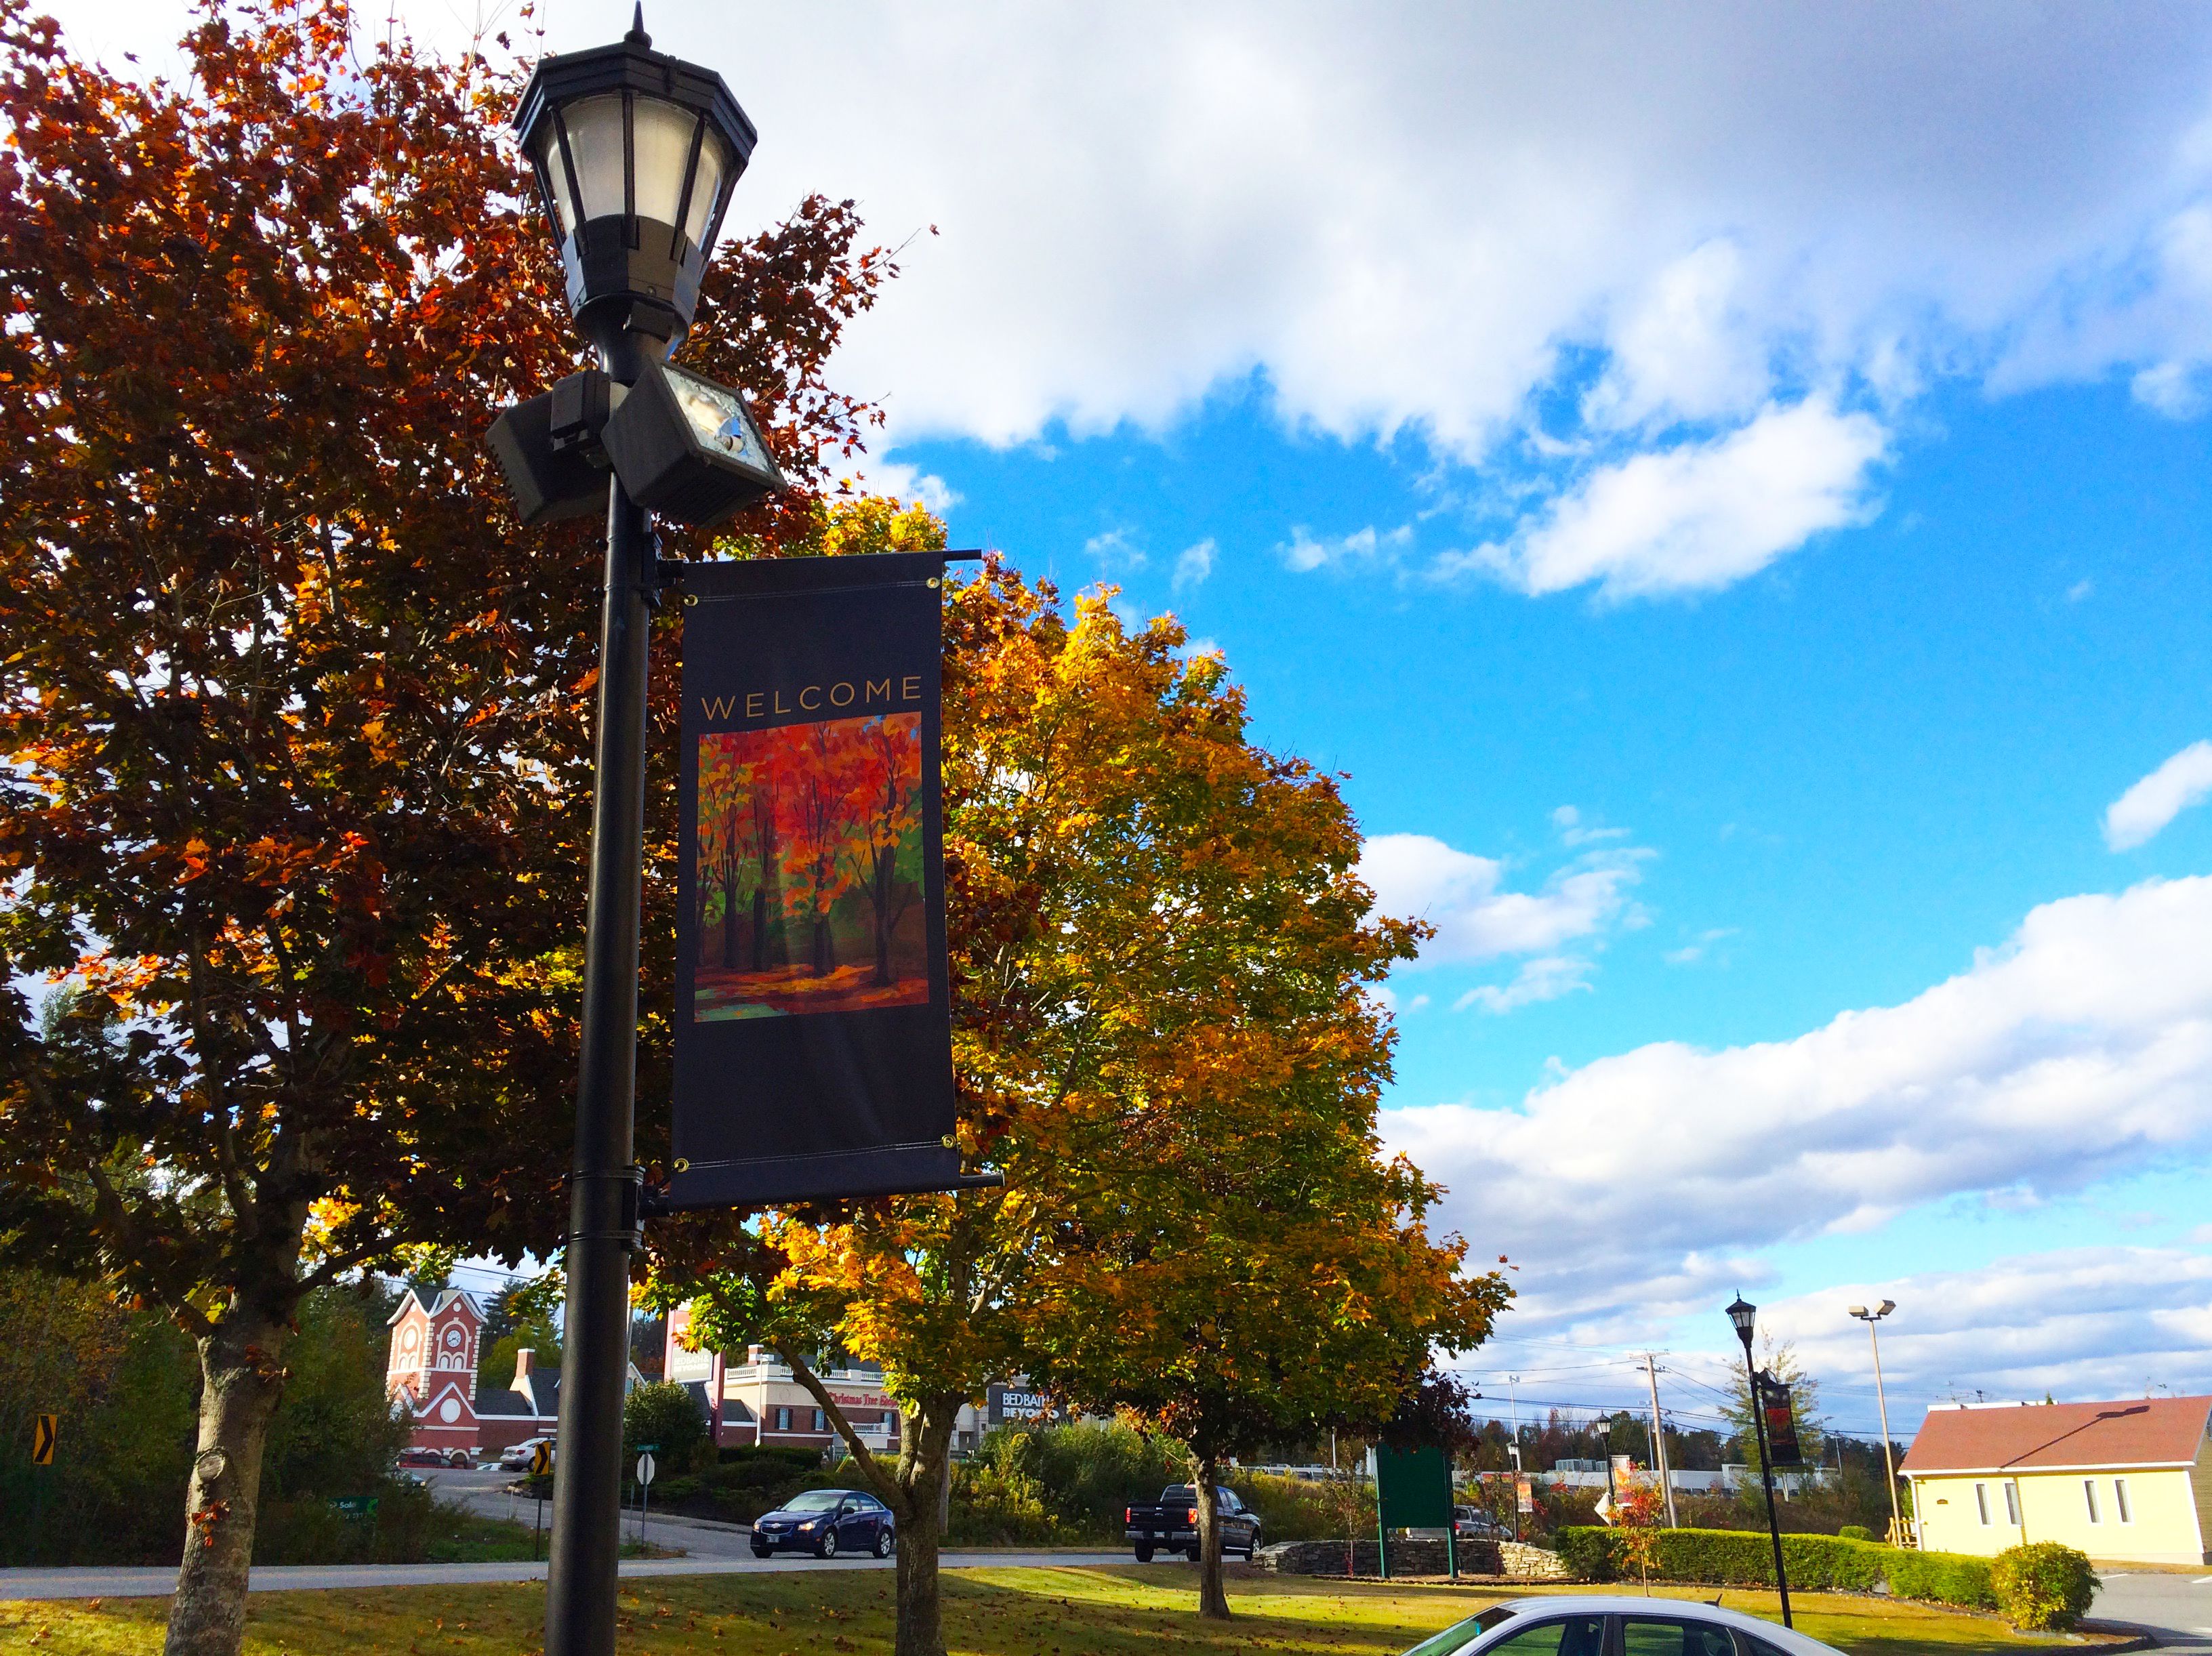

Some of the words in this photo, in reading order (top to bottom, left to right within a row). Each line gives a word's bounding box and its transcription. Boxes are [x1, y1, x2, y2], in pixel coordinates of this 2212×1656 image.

[701, 676, 922, 721] WELCOME
[674, 1357, 686, 1365] BED
[687, 1356, 703, 1364] BATH
[674, 1363, 709, 1372] BEYOND
[863, 1394, 878, 1405] Tree
[1003, 1393, 1023, 1405] BED
